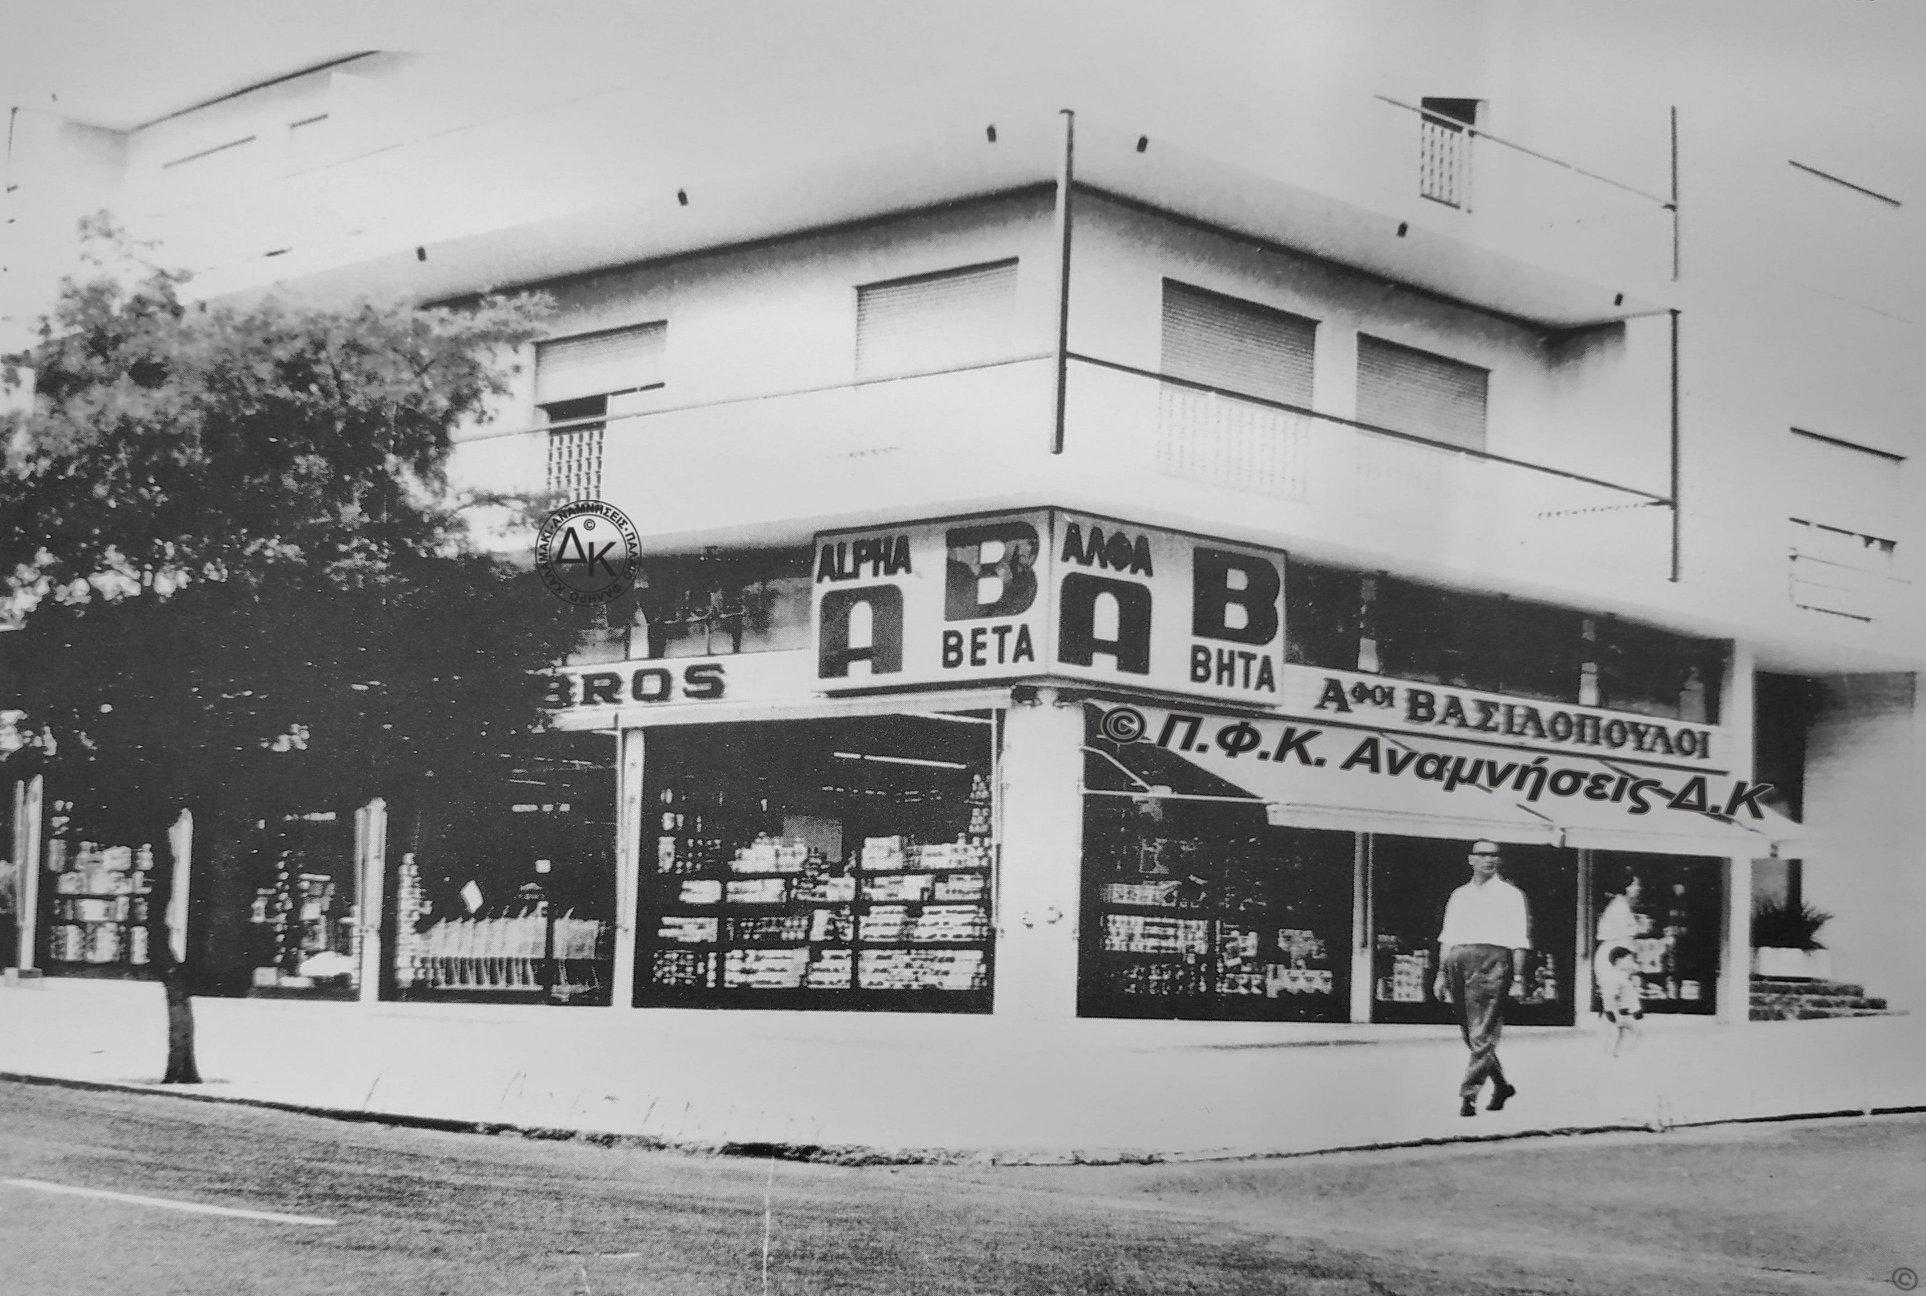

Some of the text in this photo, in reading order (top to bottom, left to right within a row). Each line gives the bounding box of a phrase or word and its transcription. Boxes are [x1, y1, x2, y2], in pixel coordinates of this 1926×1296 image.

[817, 534, 912, 583] ALPHA
[944, 521, 1039, 622] B
[1061, 522, 1153, 577] ΑΛΦΑ
[818, 583, 903, 679] A
[1058, 571, 1152, 675] Α
[1192, 546, 1280, 646] Β
[942, 623, 1035, 669] BETA
[1190, 644, 1276, 692] ΒΗΤΑ
[1403, 688, 1711, 758] ΒΑΣΙΛΟΠΟΥΛΟΙ
